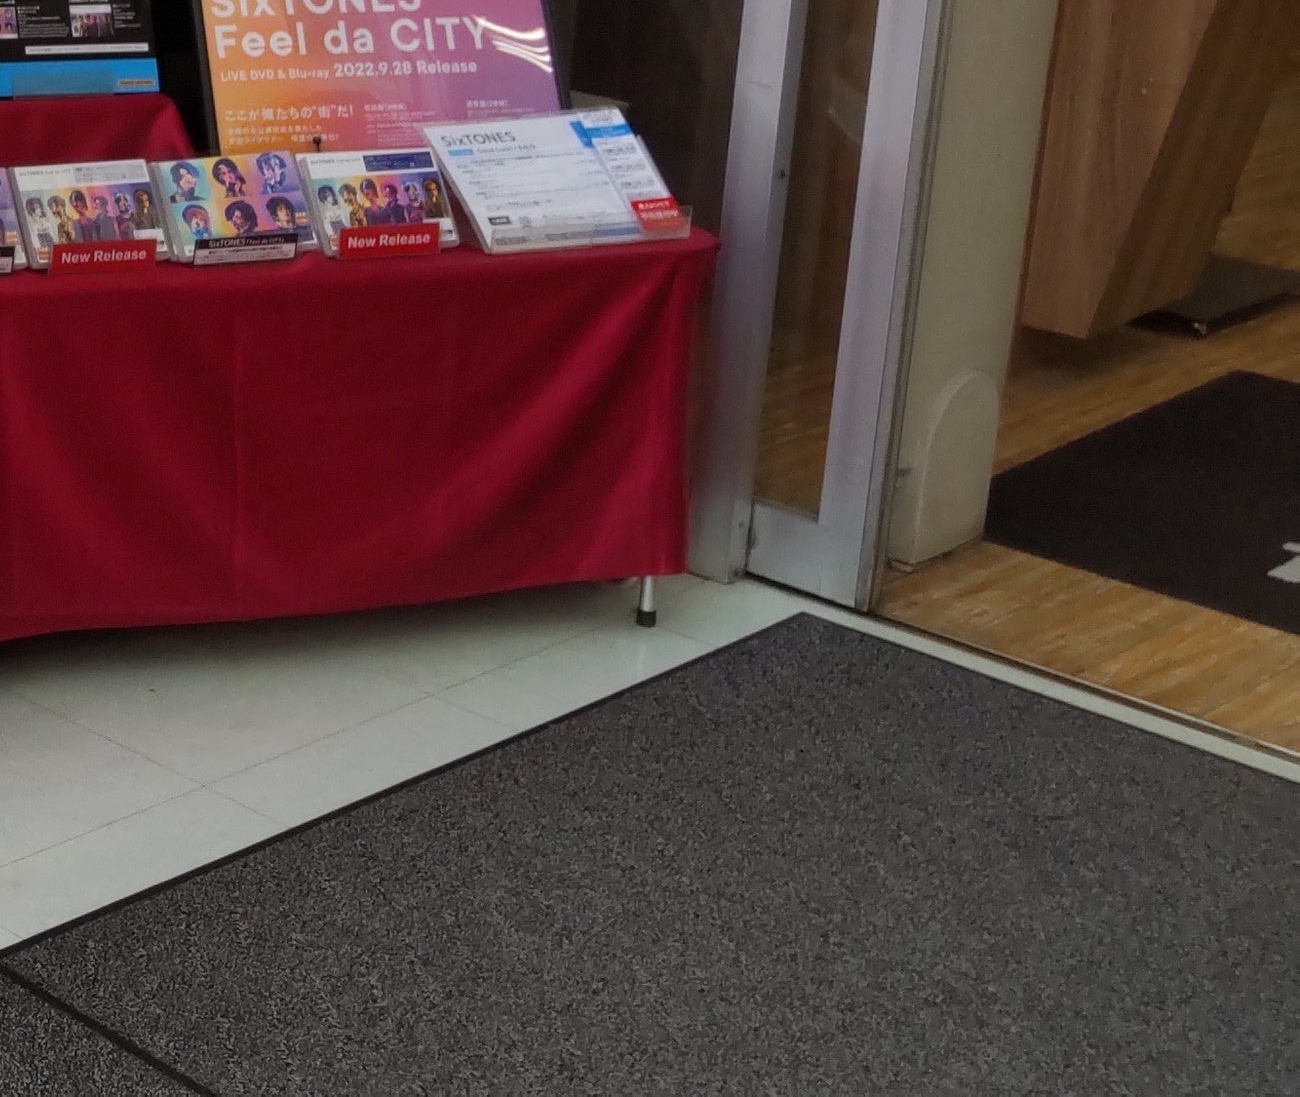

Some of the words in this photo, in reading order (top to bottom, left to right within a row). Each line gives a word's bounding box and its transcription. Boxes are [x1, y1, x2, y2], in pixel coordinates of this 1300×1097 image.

[214, 22, 306, 59] Feel
[323, 21, 375, 55] da
[390, 16, 486, 52] CITY
[220, 68, 247, 82] LIVE
[250, 67, 274, 81] DVD
[278, 67, 287, 80] &
[288, 67, 330, 81] Blu-ray
[334, 61, 412, 77] 2022.9.28
[416, 60, 477, 75] Release
[440, 131, 516, 147] SixTONES
[348, 236, 375, 249] New
[379, 233, 431, 246] Release
[61, 252, 90, 265] New
[93, 249, 147, 263] Release
